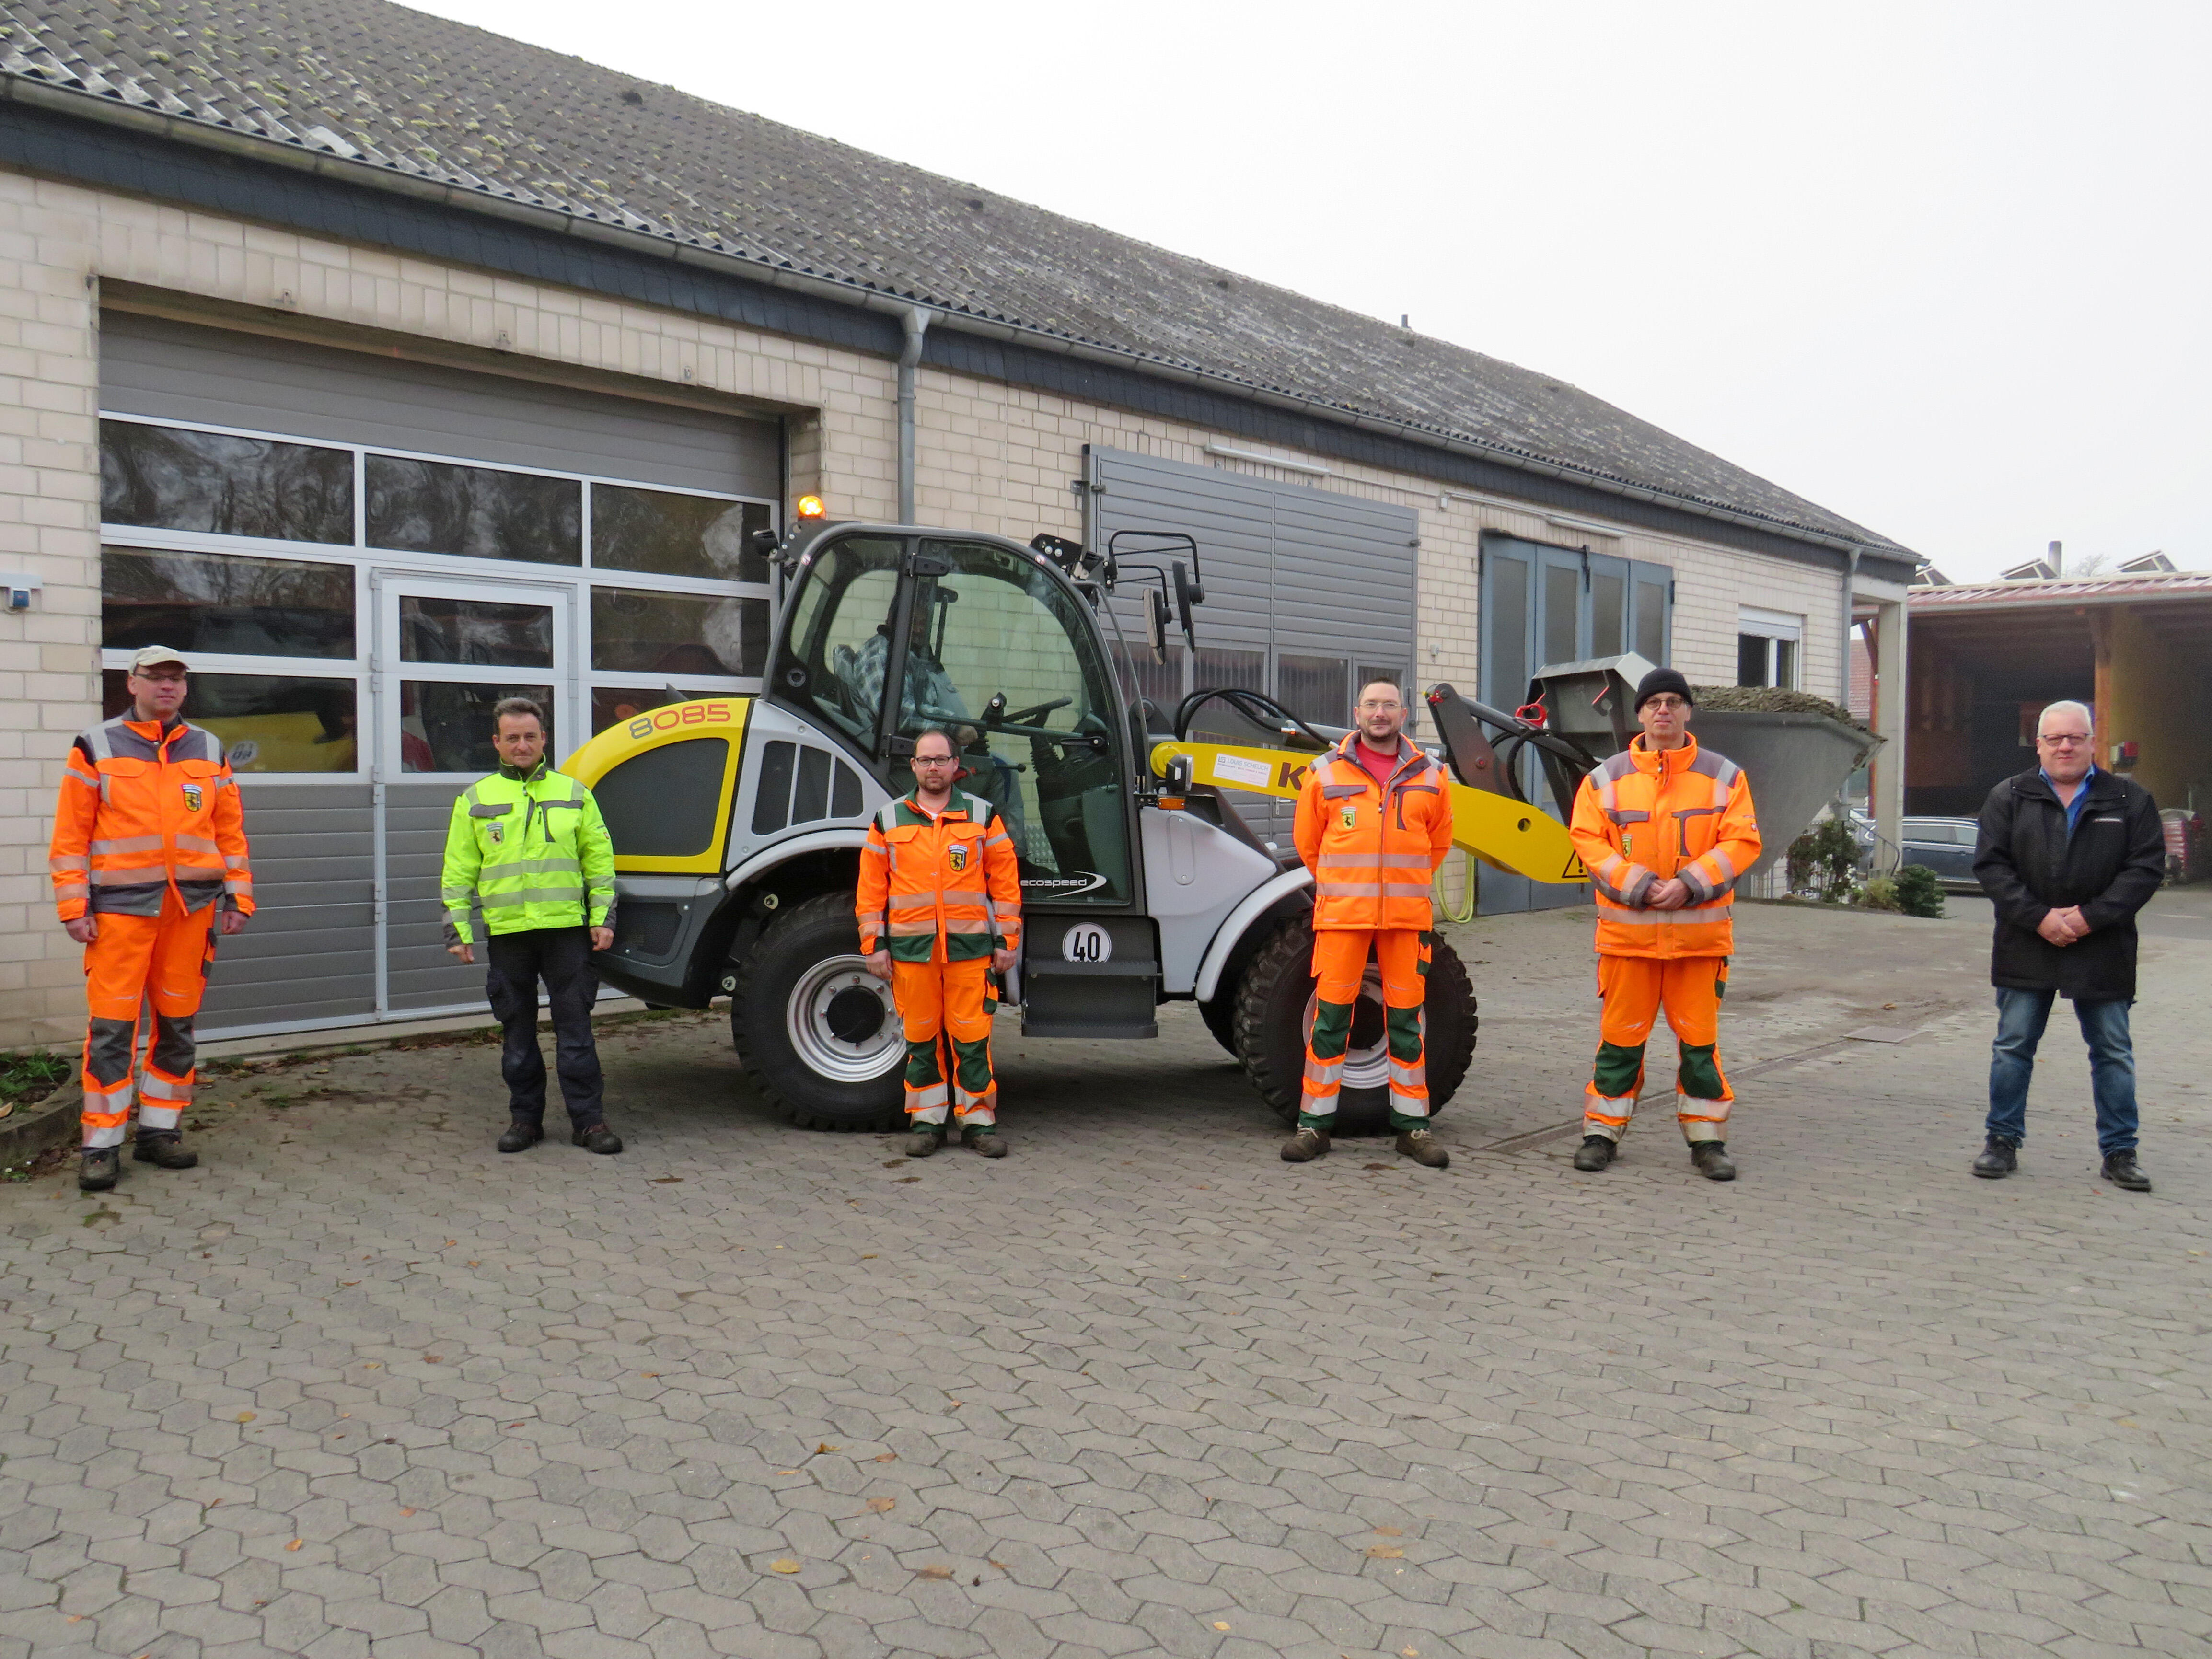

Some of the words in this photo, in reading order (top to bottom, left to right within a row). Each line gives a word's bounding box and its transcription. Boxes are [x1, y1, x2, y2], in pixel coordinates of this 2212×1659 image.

[629, 705, 730, 739] 8085
[1244, 762, 1269, 771] SCHEUCH
[1021, 879, 1087, 887] ecospeed
[1073, 932, 1100, 961] 40
